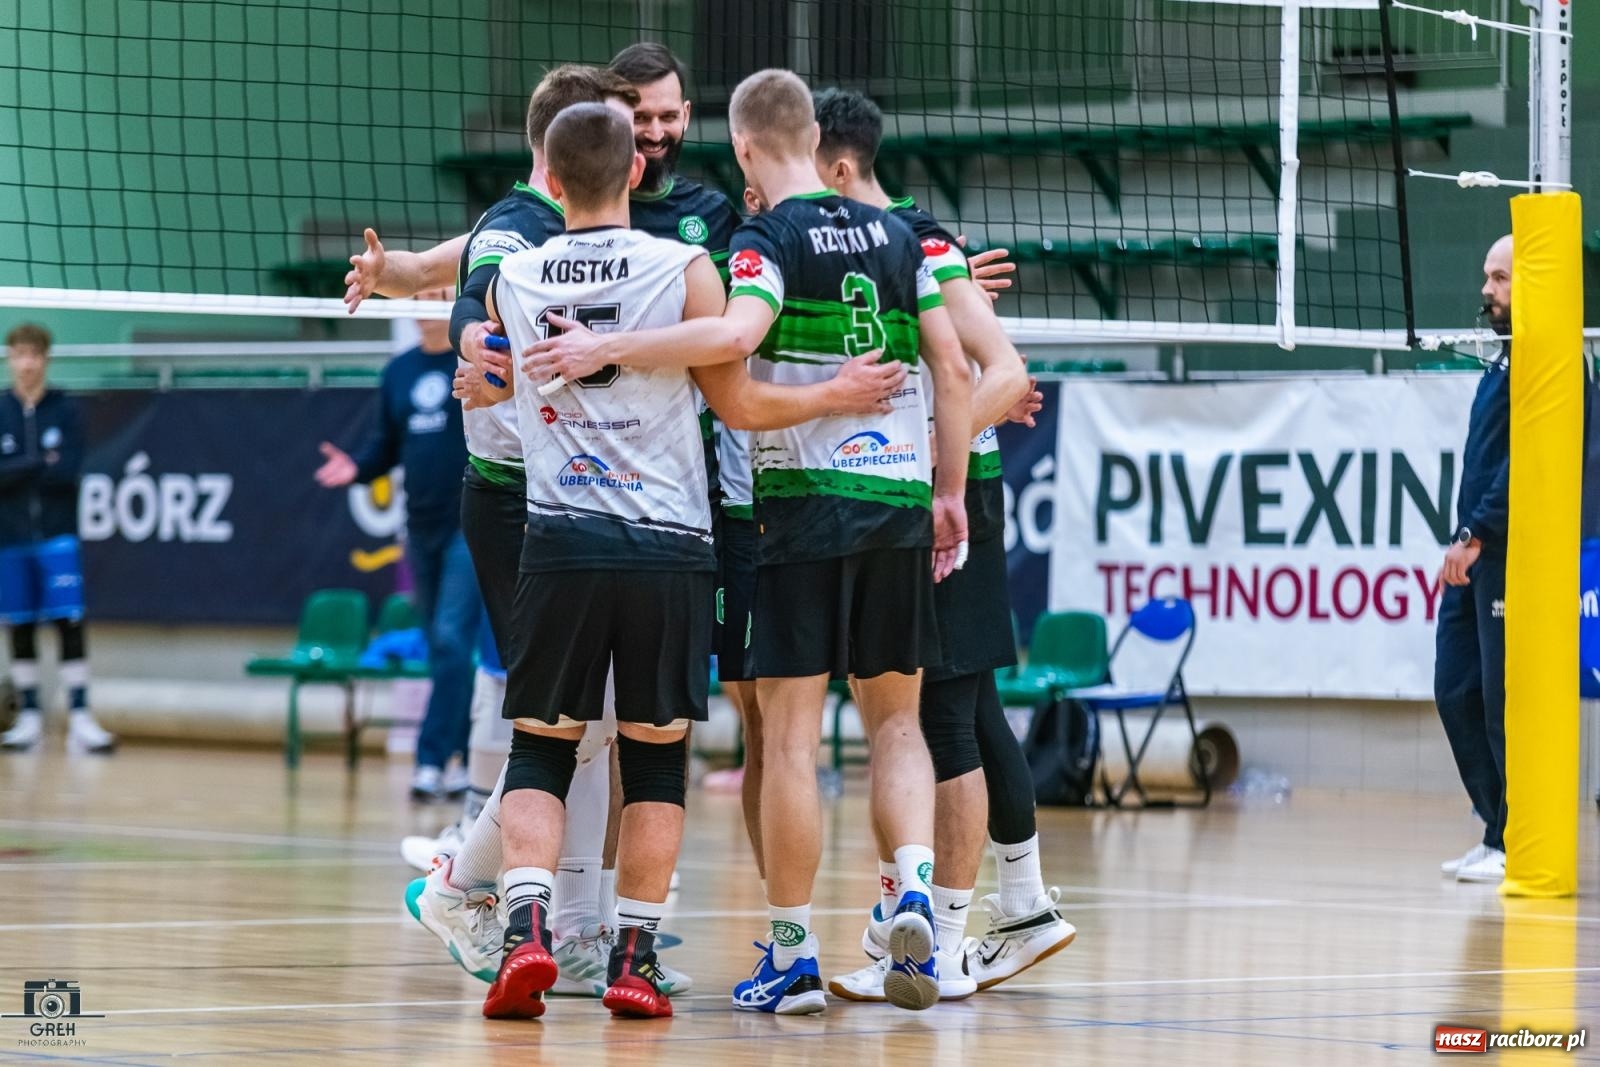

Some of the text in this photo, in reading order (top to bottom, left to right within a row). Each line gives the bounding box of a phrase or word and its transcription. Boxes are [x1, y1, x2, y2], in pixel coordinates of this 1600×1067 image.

[1560, 59, 1568, 127] sport
[866, 220, 889, 248] M
[540, 257, 629, 284] KOSTKA
[841, 272, 887, 358] 3
[832, 453, 917, 468] UBEZPIECZENIA
[884, 444, 914, 454] MULTI
[1095, 448, 1454, 547] PIVEXIN
[1097, 561, 1441, 624] TECHNOLOGY
